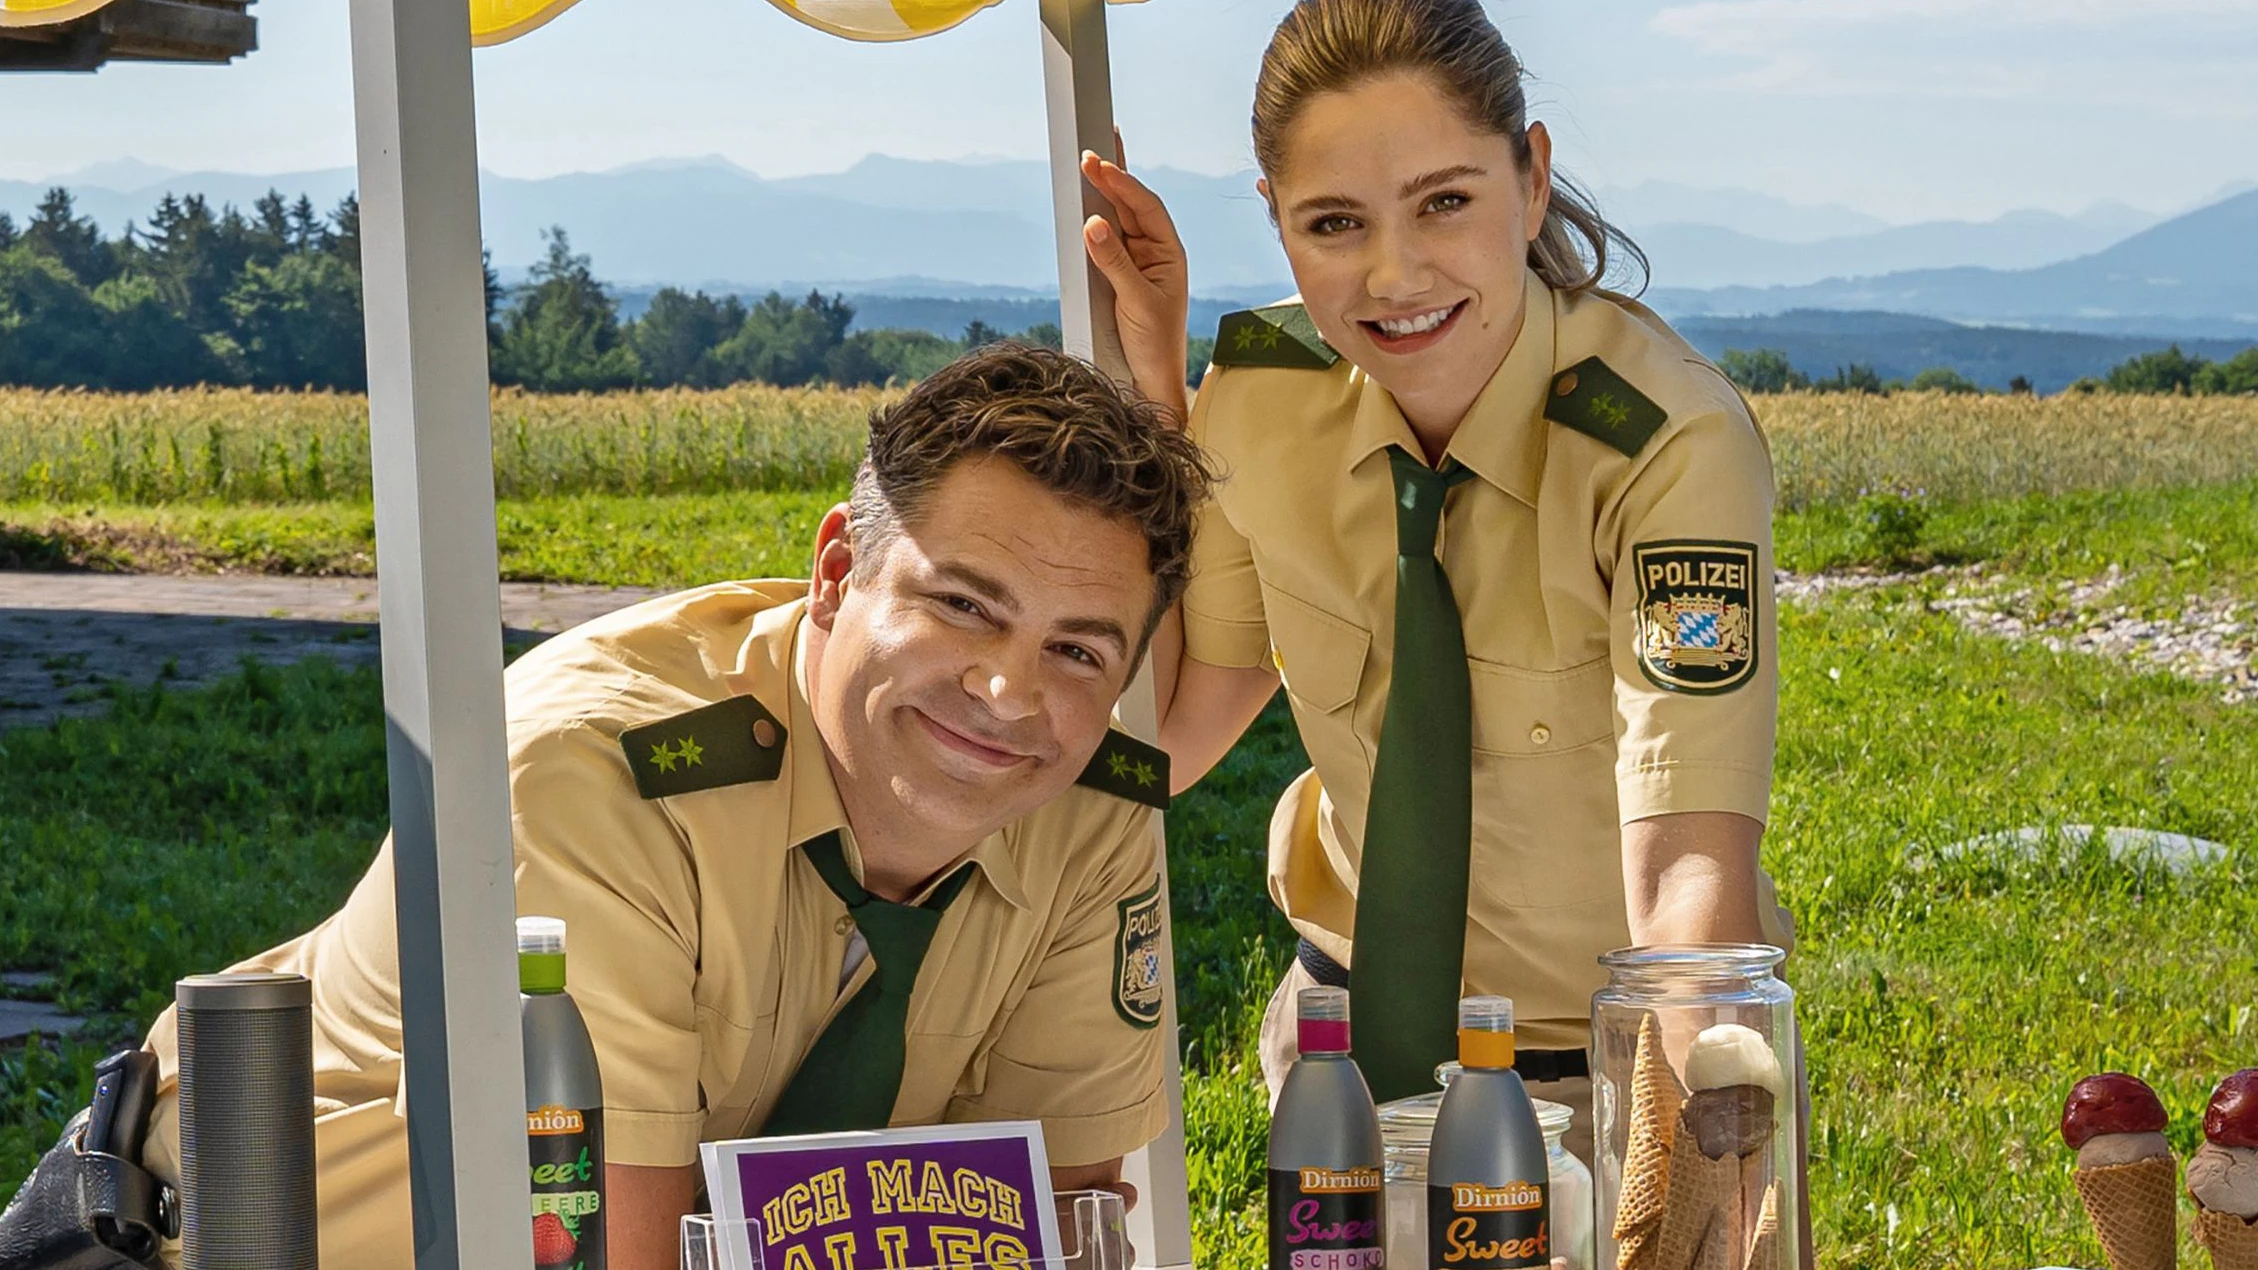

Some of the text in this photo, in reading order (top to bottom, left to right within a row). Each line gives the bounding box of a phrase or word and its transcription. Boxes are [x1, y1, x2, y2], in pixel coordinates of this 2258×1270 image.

[1647, 561, 1746, 590] POLIZEI
[527, 1110, 580, 1130] niôn
[529, 1147, 592, 1184] eet
[541, 1194, 597, 1211] EERE
[762, 1159, 1026, 1246] ICH MACH
[1456, 1185, 1539, 1208] Dirniôn
[1286, 1199, 1377, 1244] Swee
[1443, 1216, 1549, 1263] Sweet
[1294, 1250, 1383, 1270] SCHOKO
